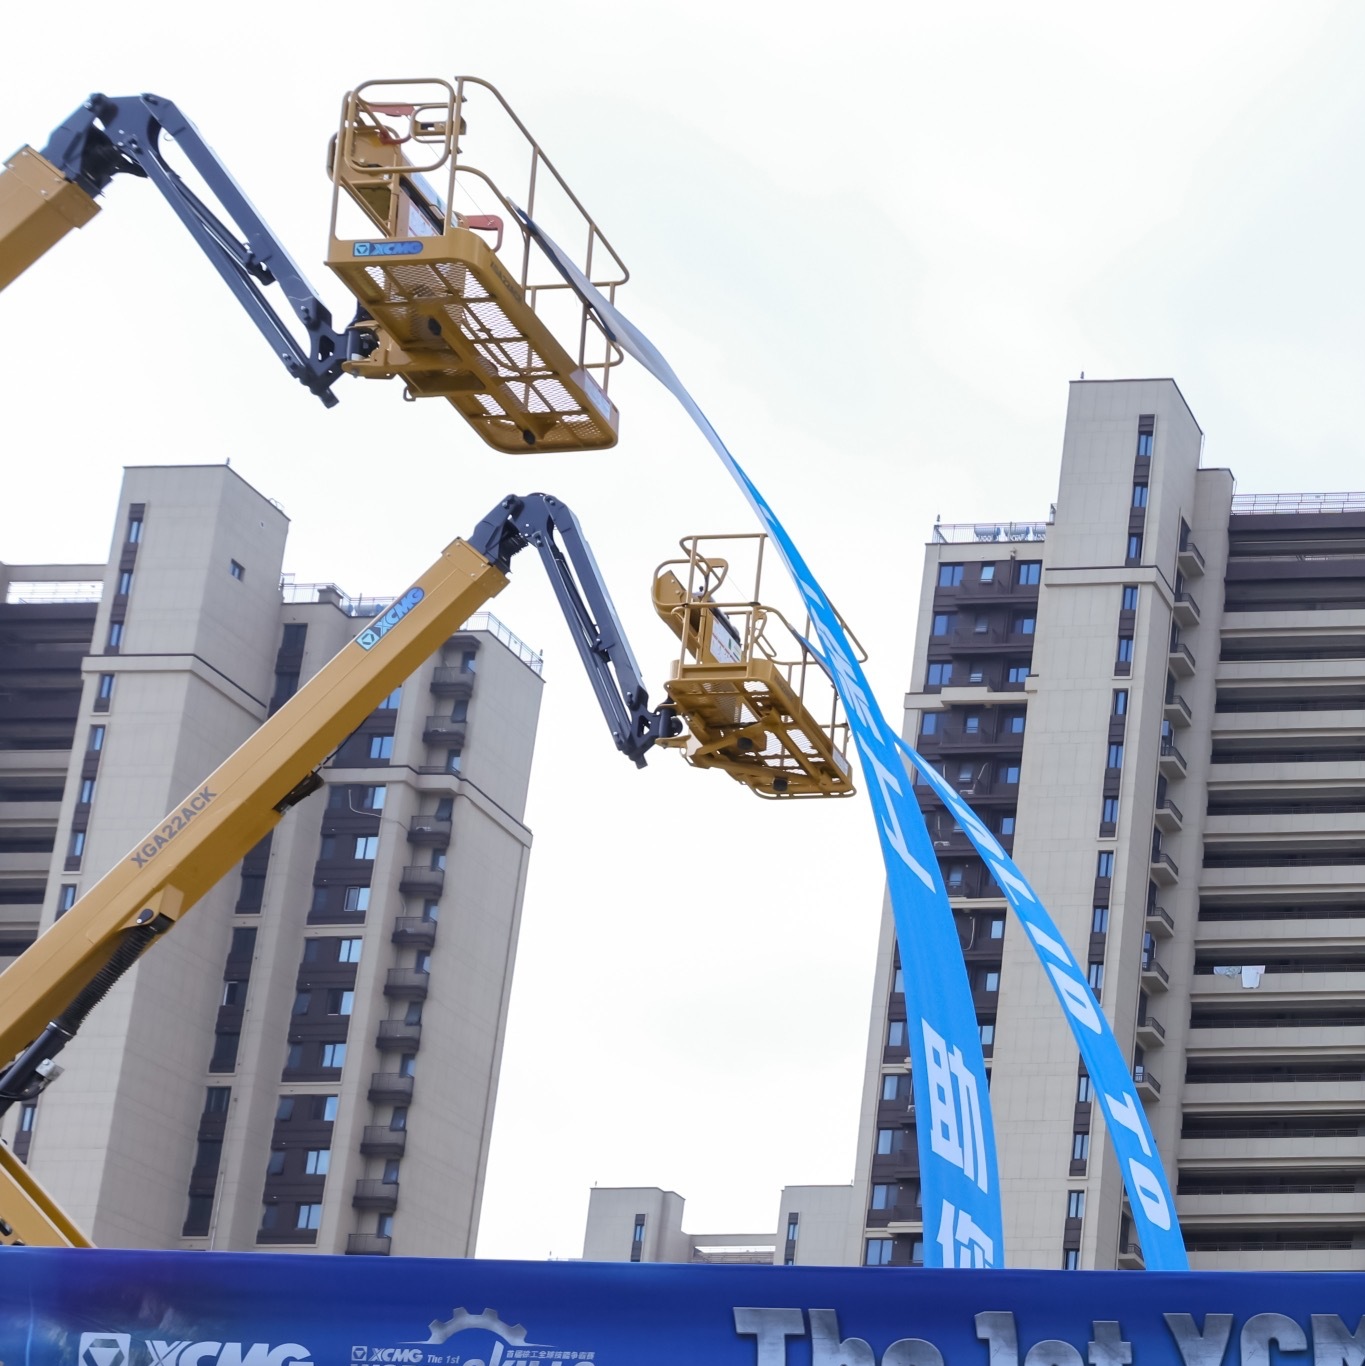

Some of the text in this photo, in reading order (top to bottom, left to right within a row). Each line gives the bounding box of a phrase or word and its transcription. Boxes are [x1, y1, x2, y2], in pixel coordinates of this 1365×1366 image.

[374, 586, 425, 638] XCMG
[131, 786, 217, 869] XGA22ACK
[1105, 1091, 1171, 1231] TO
[369, 1348, 461, 1365] XCMG The 1st
